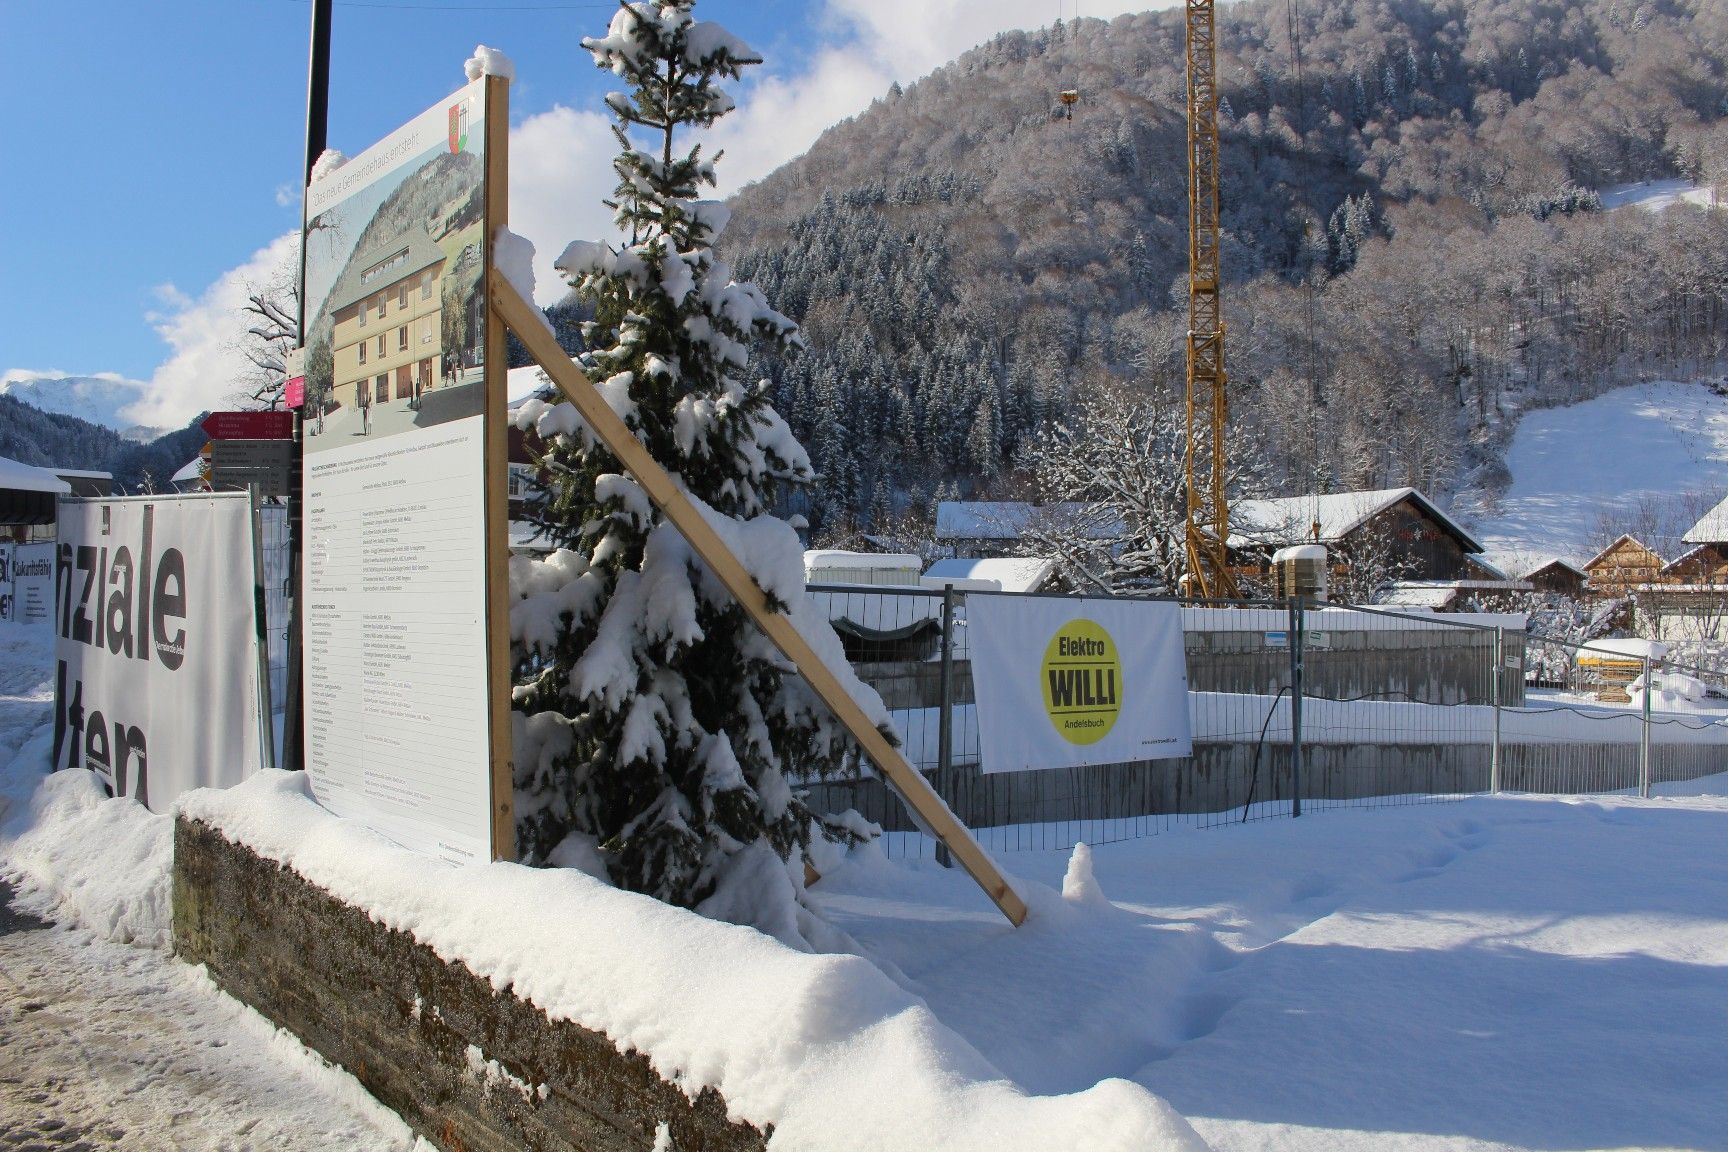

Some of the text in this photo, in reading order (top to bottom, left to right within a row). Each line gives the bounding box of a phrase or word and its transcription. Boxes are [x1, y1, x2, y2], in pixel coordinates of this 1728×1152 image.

[1059, 636, 1105, 656] Elektro
[1049, 669, 1116, 707] WILLI
[1064, 718, 1105, 729] Andelsbuch
